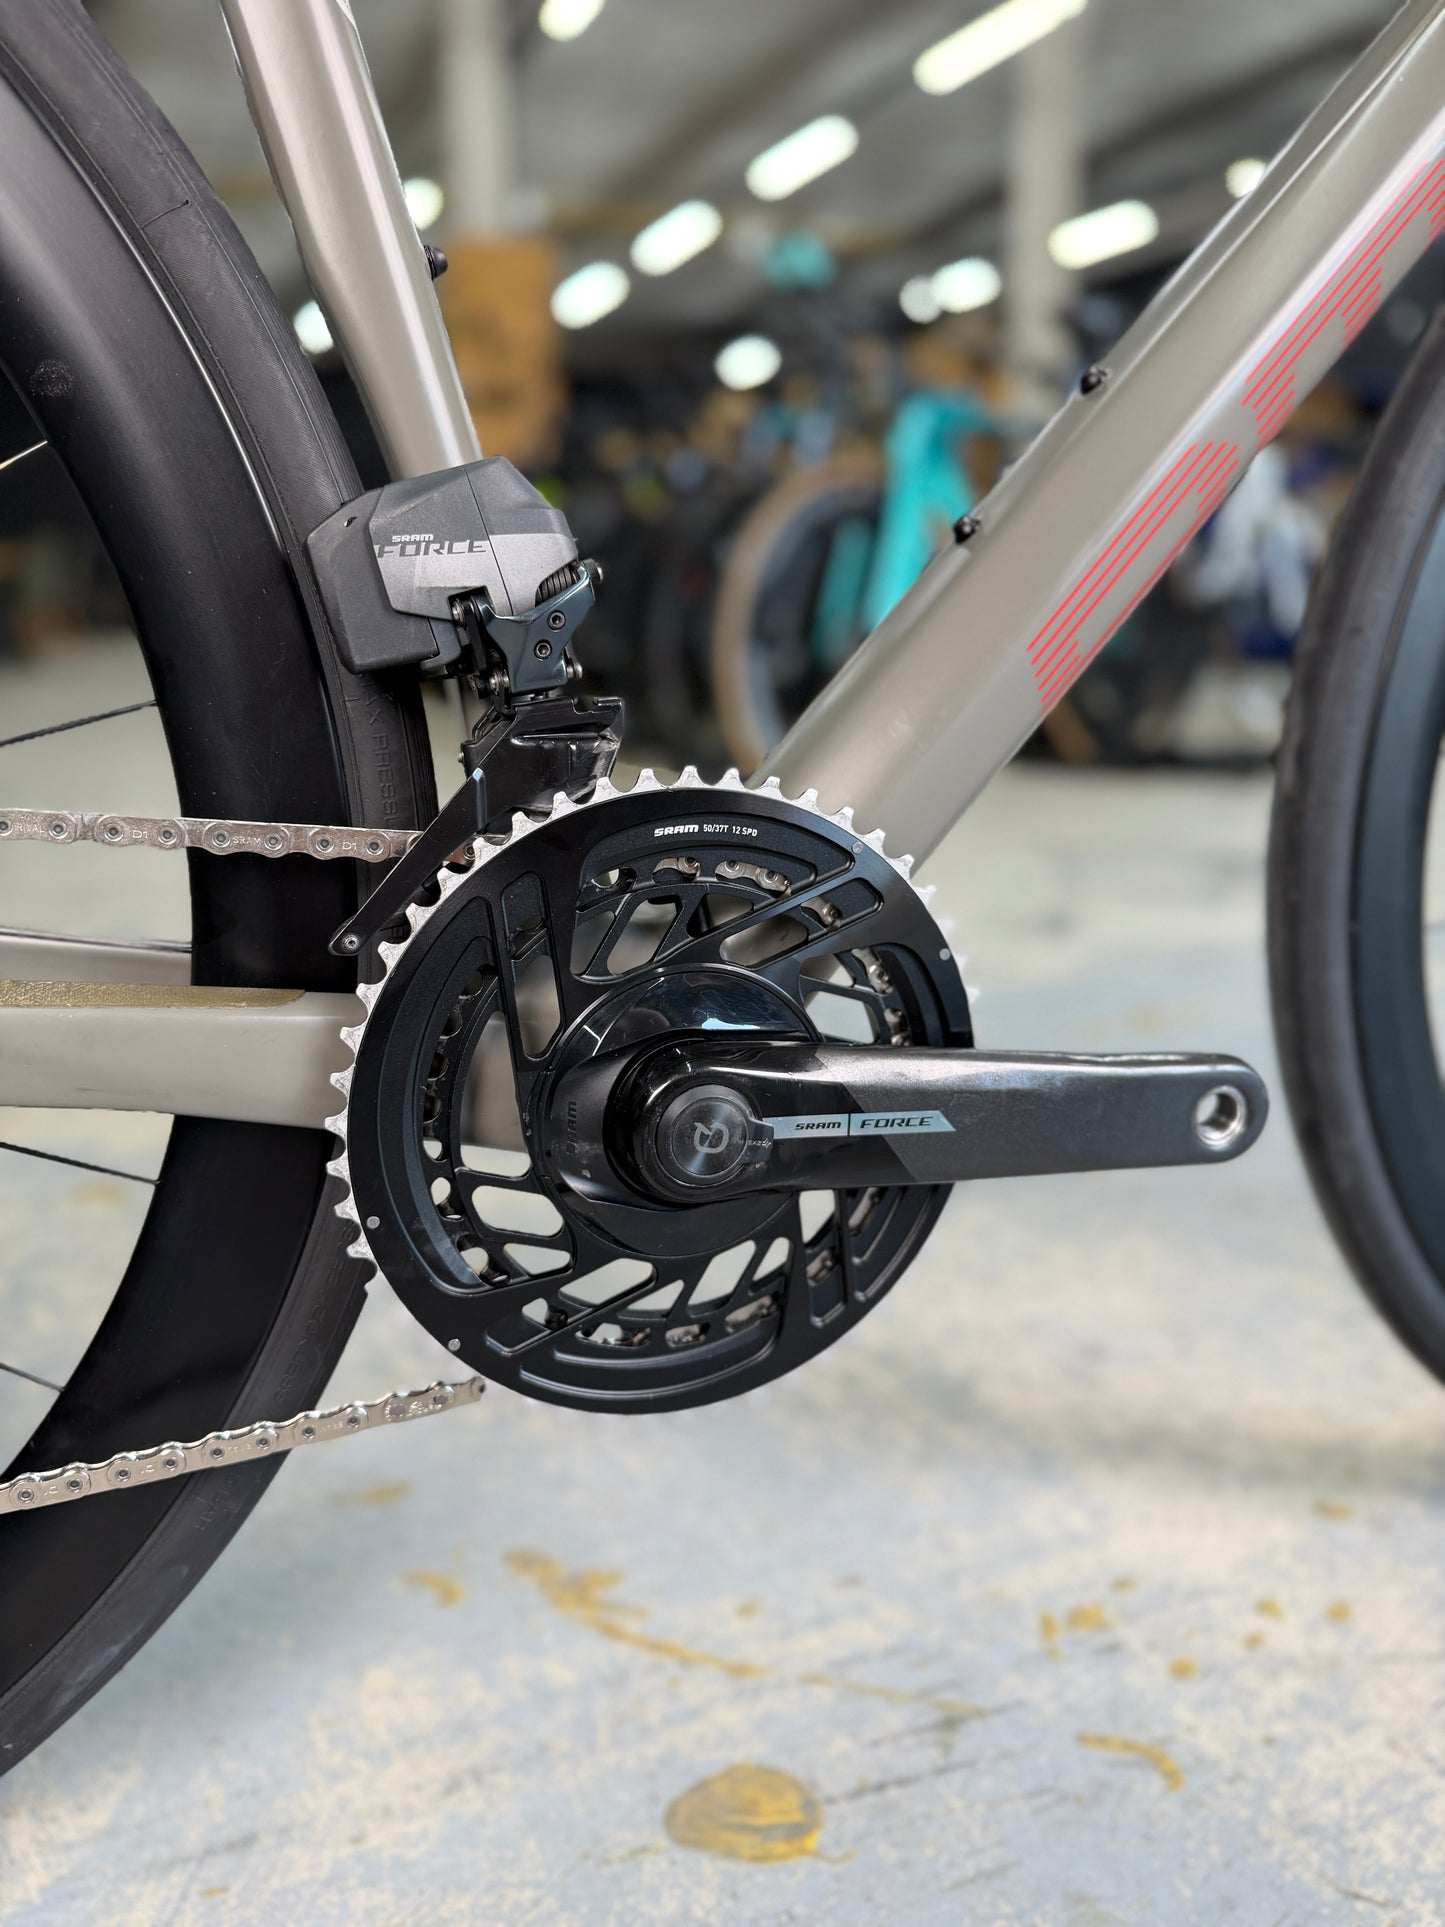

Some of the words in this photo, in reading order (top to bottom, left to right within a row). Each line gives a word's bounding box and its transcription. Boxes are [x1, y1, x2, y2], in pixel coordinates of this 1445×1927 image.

[391, 533, 434, 543] SRAM
[377, 539, 487, 559] FORCE
[371, 733, 400, 830] PRESS
[653, 824, 700, 838] SRAM
[702, 823, 729, 834] 50/37T
[731, 825, 741, 836] 12
[741, 826, 759, 838] SPD
[232, 835, 262, 848] SRAM
[341, 841, 358, 851] D1
[567, 1100, 577, 1155] SRAM
[794, 1120, 842, 1132] SRAM
[859, 1116, 935, 1130] FORCE
